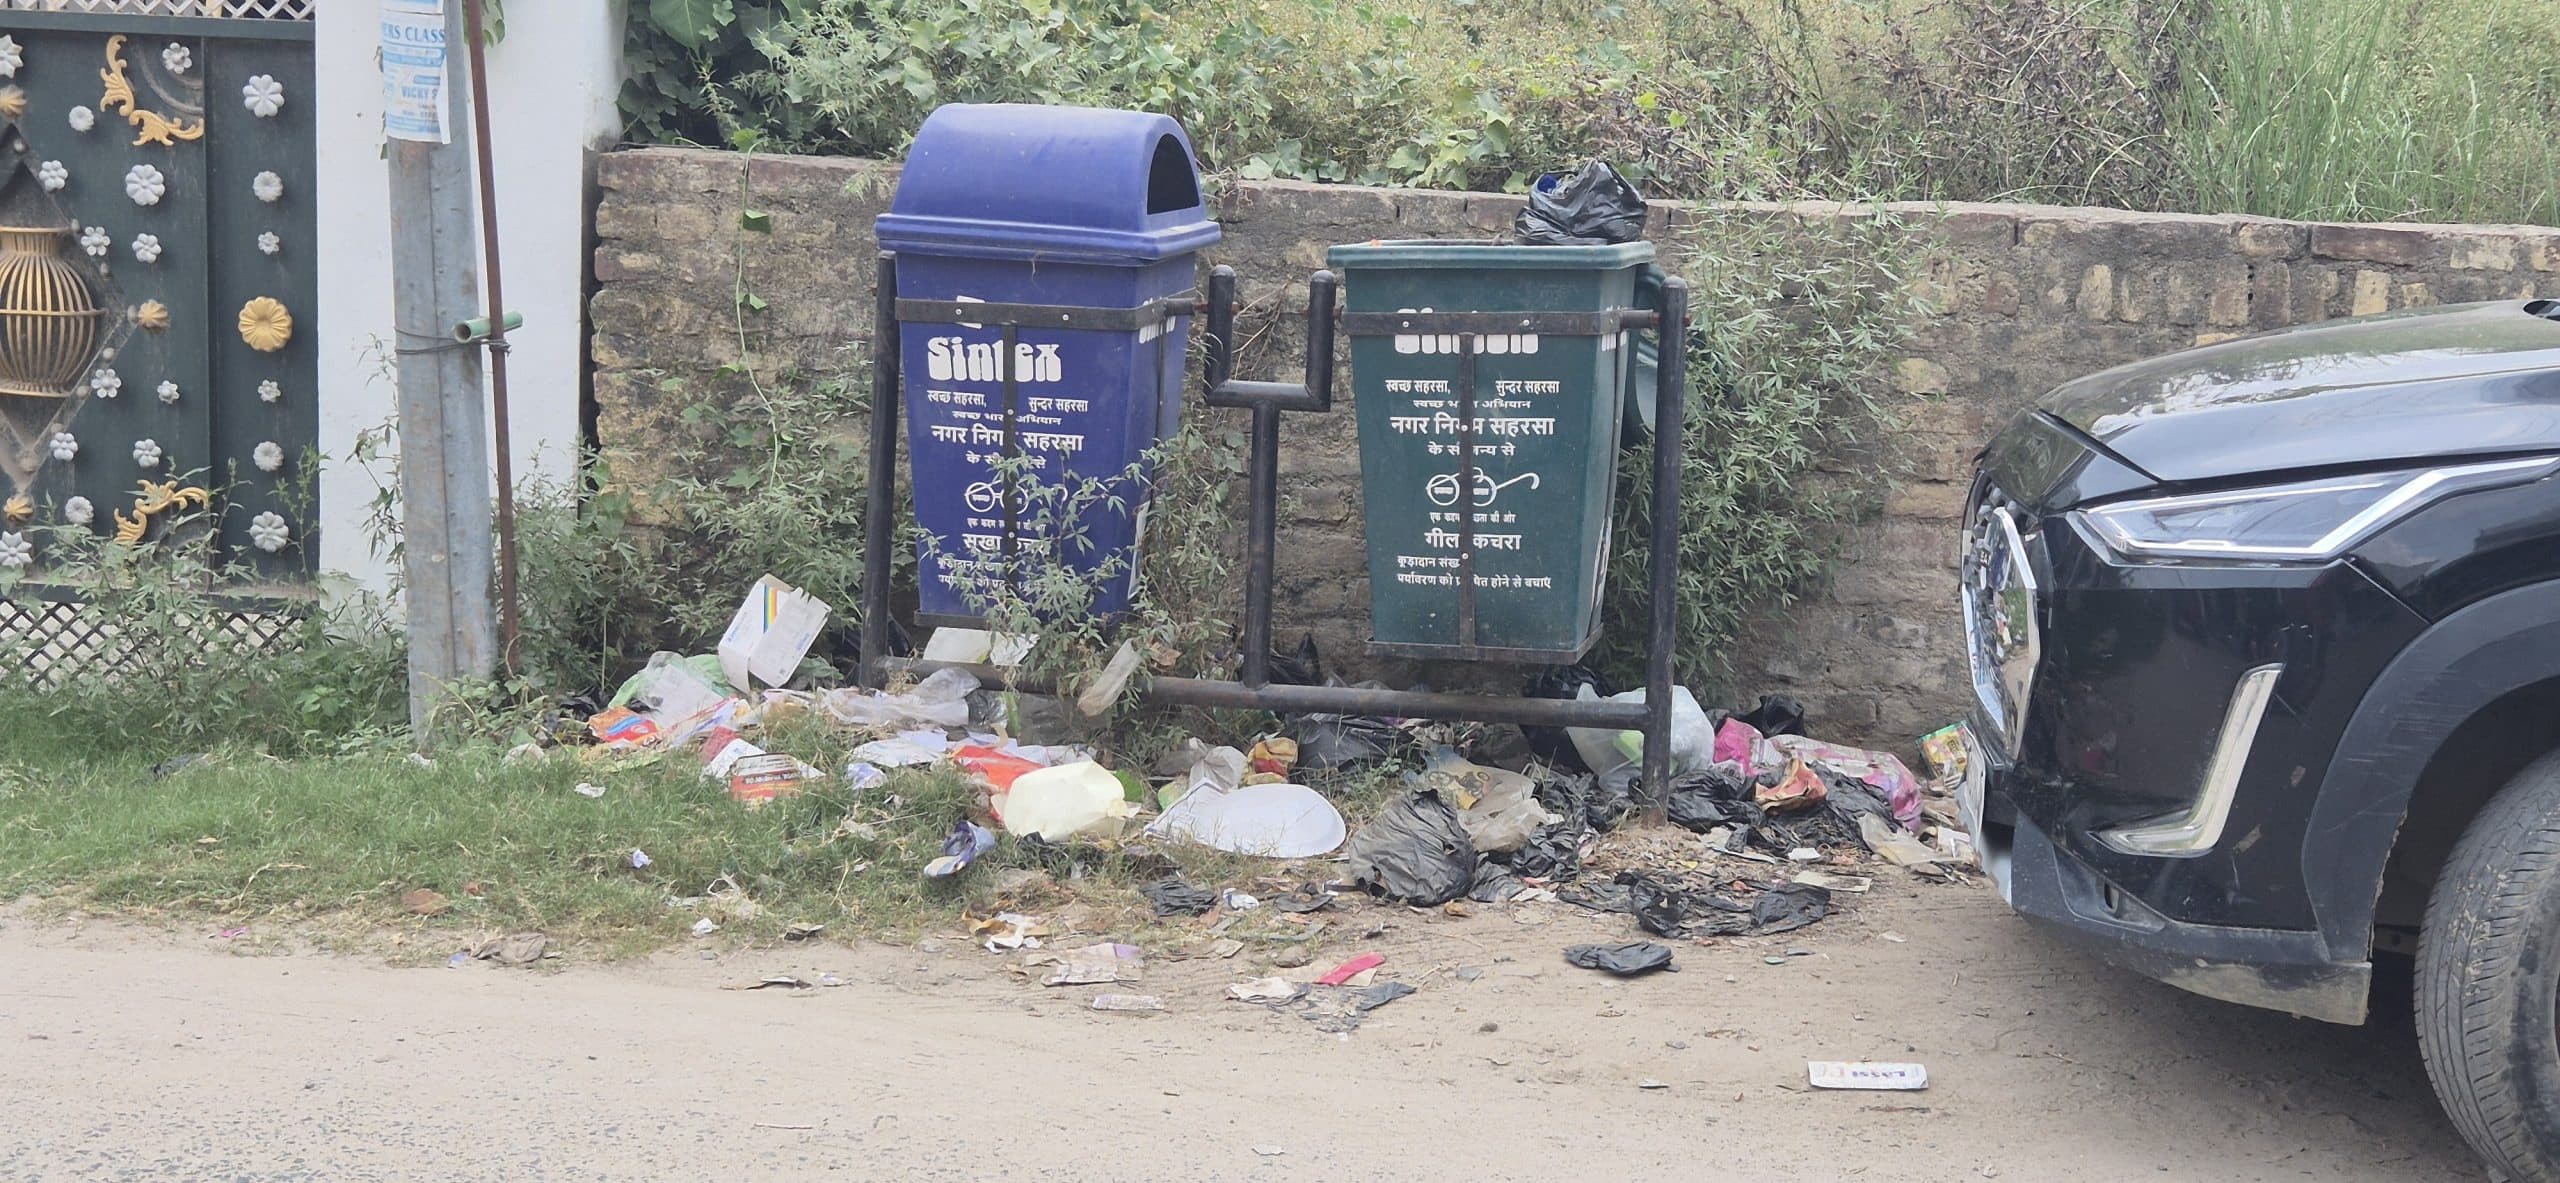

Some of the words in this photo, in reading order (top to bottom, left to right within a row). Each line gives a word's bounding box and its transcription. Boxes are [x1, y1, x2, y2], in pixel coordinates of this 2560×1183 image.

[1385, 379, 1412, 393] स्वच्छ
[1495, 380, 1522, 396] सुन्दर
[1524, 380, 1560, 396] सहरसा
[926, 389, 951, 403] स्वच्छ
[1028, 396, 1053, 413] सुन्दर
[1055, 398, 1089, 413] सहरसा
[1413, 399, 1444, 409] स्वच्छ
[1481, 398, 1531, 409] अभियान
[952, 411, 981, 423] स्वच्छ
[984, 412, 1004, 423] भार
[1016, 414, 1062, 426] अभियान
[1390, 416, 1430, 435] नगर
[1489, 417, 1556, 437] सहरसा
[930, 424, 969, 444] नगर
[971, 423, 1019, 447] निग
[1022, 431, 1085, 452] सहरसा
[965, 450, 981, 464] के
[1427, 440, 1444, 456] के
[1500, 442, 1515, 457] से
[1424, 527, 1460, 549] गील
[1473, 533, 1522, 550] कचरा
[1397, 571, 1436, 586] पर्यावरण
[1439, 573, 1453, 586] को
[1490, 574, 1510, 589] होने
